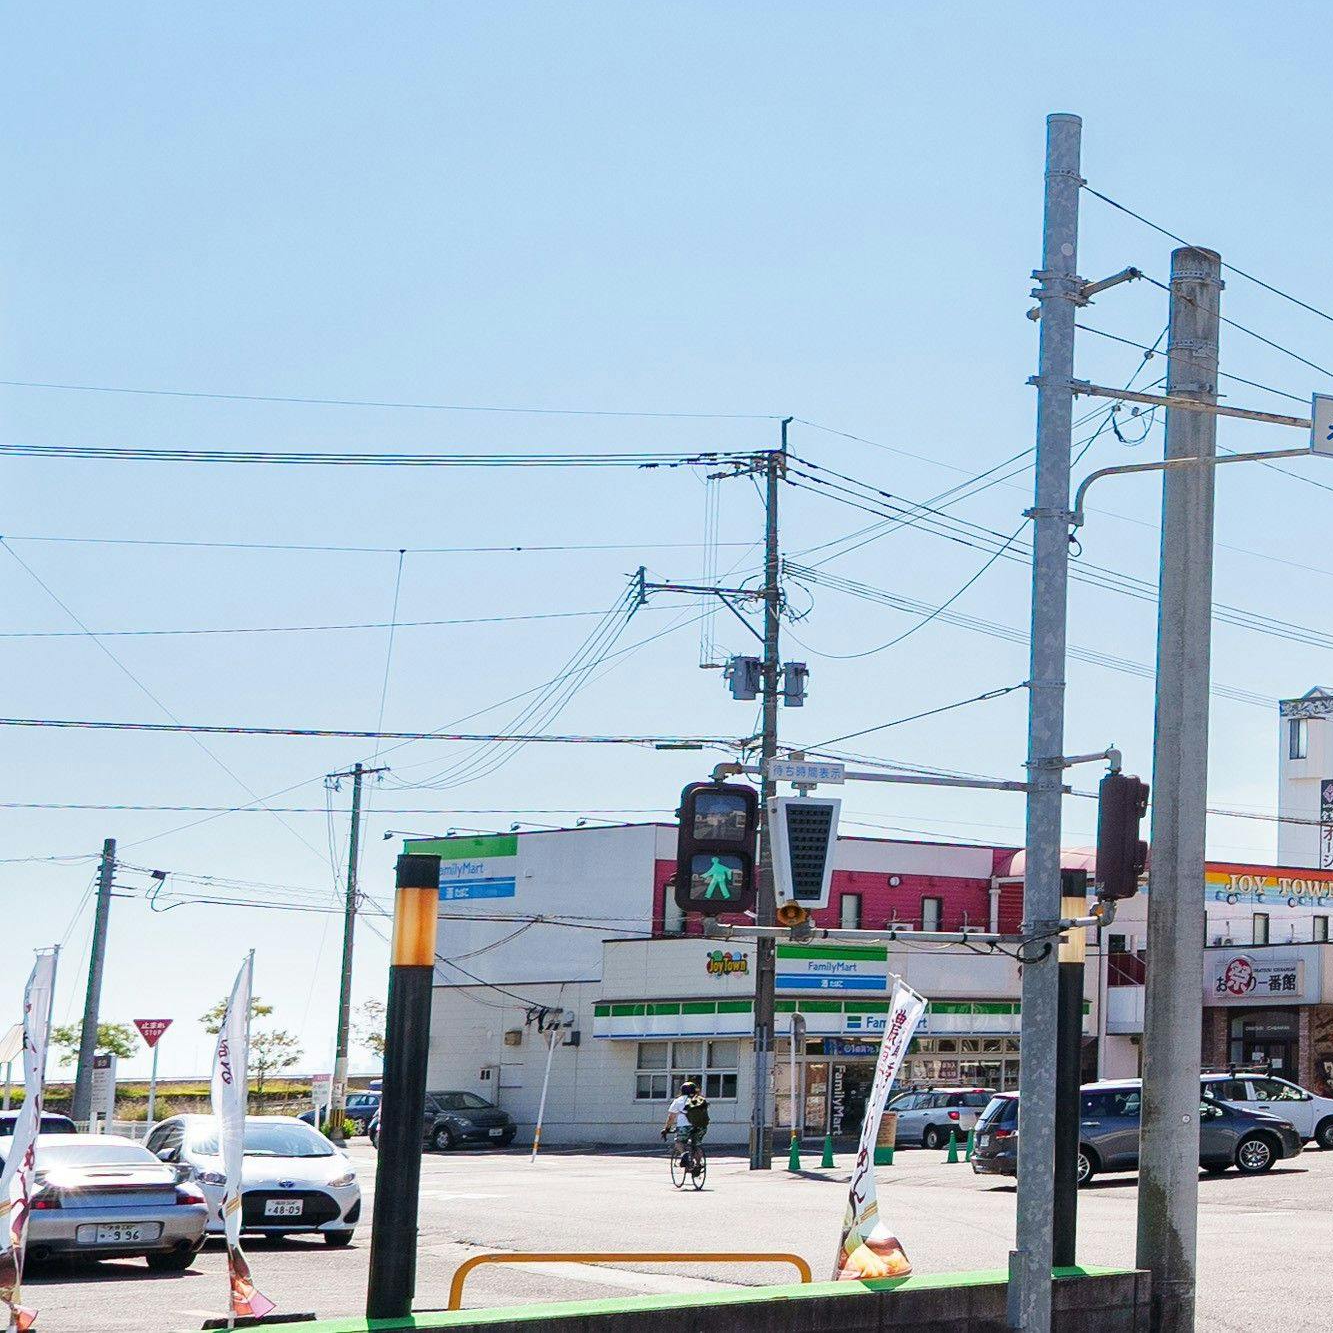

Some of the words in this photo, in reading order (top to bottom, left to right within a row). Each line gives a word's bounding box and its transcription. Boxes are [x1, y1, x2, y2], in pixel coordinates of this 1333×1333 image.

[773, 763, 842, 780] 待ち時間表示
[439, 862, 484, 878] amilyMart
[1226, 874, 1269, 894] JOY
[708, 957, 747, 974] JoyTown
[808, 961, 857, 974] FamilyMart
[144, 1029, 162, 1037] STOP
[832, 1065, 846, 1136] FamilyMart
